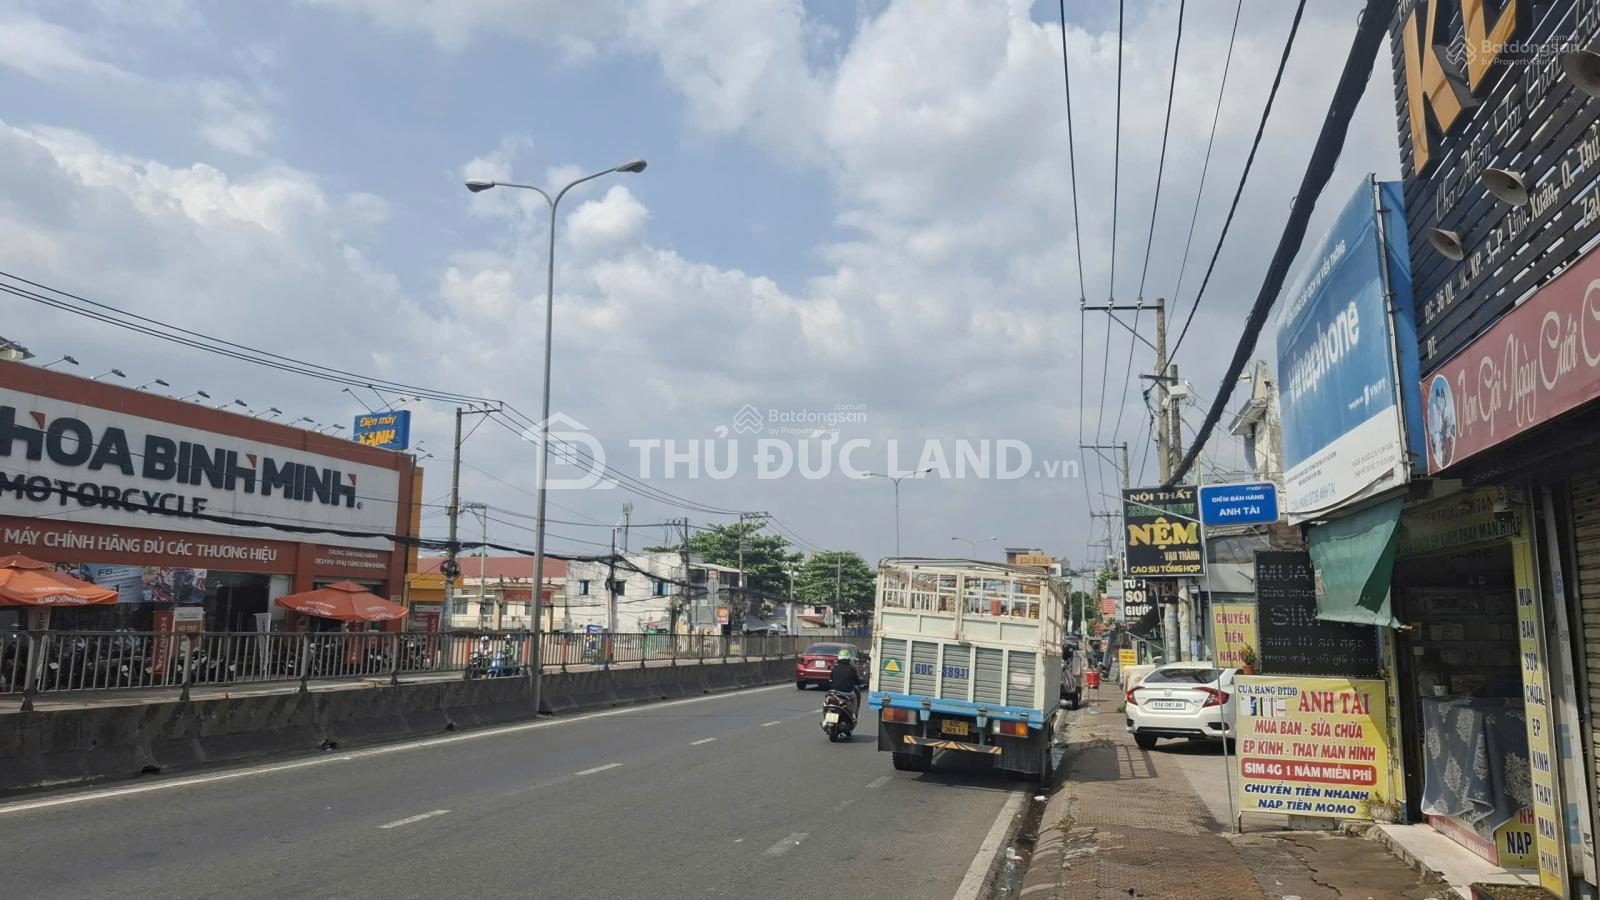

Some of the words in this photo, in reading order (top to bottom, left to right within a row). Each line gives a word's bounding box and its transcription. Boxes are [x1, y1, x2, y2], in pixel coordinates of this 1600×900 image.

[1540, 311, 1578, 390] Cưới
[1129, 492, 1154, 502] NỘI
[1157, 488, 1193, 500] THẤT
[1219, 507, 1241, 516] ANH
[1242, 505, 1261, 515] TÀI
[1127, 517, 1200, 550] NỆM
[4, 526, 40, 546] MÁY
[43, 530, 95, 550] CHÍNH
[97, 533, 141, 553] HÃNG
[143, 536, 164, 554] ĐỦ
[167, 539, 193, 556] CÁC
[196, 543, 248, 560] THƯƠNG
[249, 545, 278, 564] HIỆU
[1131, 566, 1149, 574] CAO
[1519, 588, 1533, 607] MUA
[1298, 690, 1335, 714] ANH
[1339, 687, 1371, 715] TÀI
[1254, 719, 1277, 735] MUA
[1280, 718, 1302, 735] BÁN
[1310, 717, 1331, 738] SỬA
[1334, 721, 1364, 739] CHỮA
[1243, 736, 1256, 754] ÉP
[1258, 738, 1284, 756] KÍNH
[1292, 742, 1319, 758] THAY
[1321, 742, 1346, 759] MÀN
[1348, 744, 1376, 761] HÌNH
[1244, 762, 1265, 774] SIM
[1266, 763, 1282, 775] 4G
[1285, 765, 1291, 776] 1
[1352, 767, 1372, 782] PHÍ
[1244, 781, 1292, 796] CHUYỂN
[1295, 784, 1321, 798] TIỀN
[1324, 788, 1369, 801] NHANH
[1535, 783, 1552, 806] THAY
[1258, 799, 1283, 811] NẠP
[1286, 797, 1312, 811] TIỀN
[1315, 803, 1357, 814] MOMO
[1506, 831, 1533, 860] NẠP
